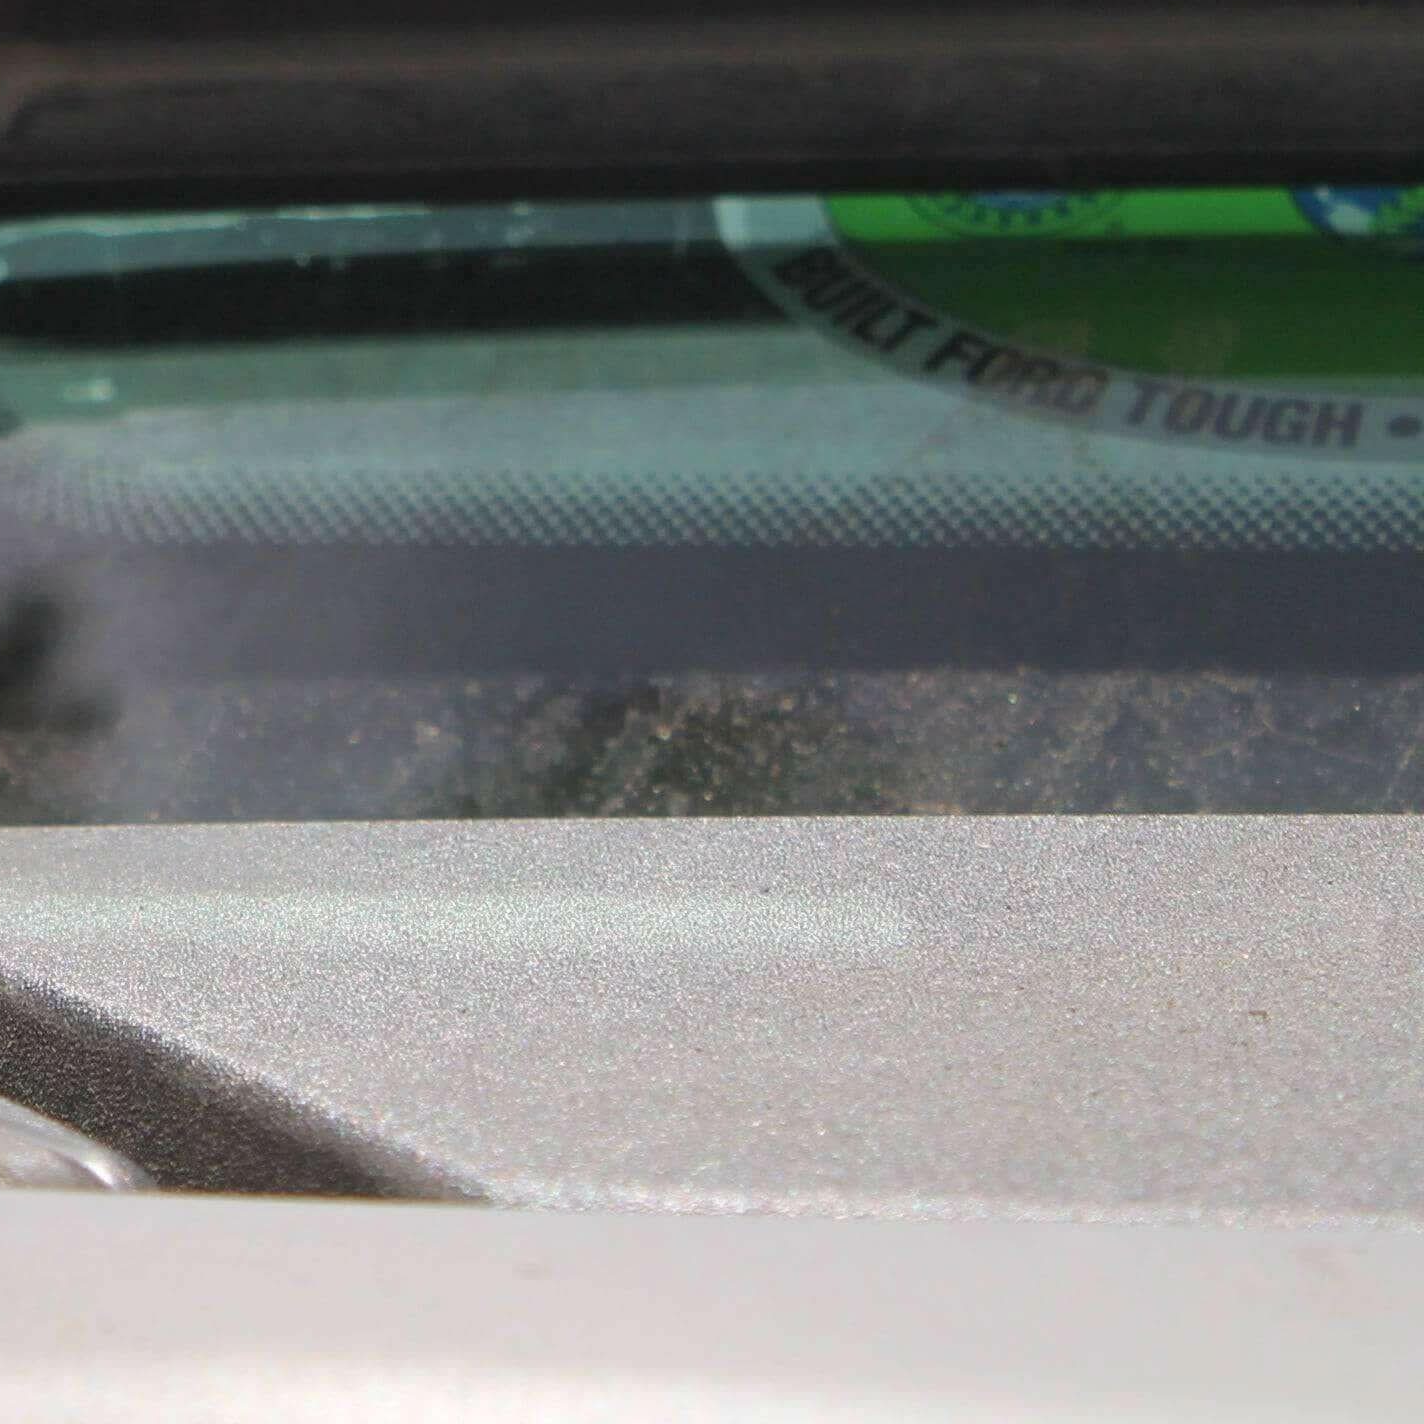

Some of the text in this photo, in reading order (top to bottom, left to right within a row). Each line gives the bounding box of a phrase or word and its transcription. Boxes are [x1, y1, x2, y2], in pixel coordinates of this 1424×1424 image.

[771, 246, 1364, 447] BUILT FORD TOUGH
